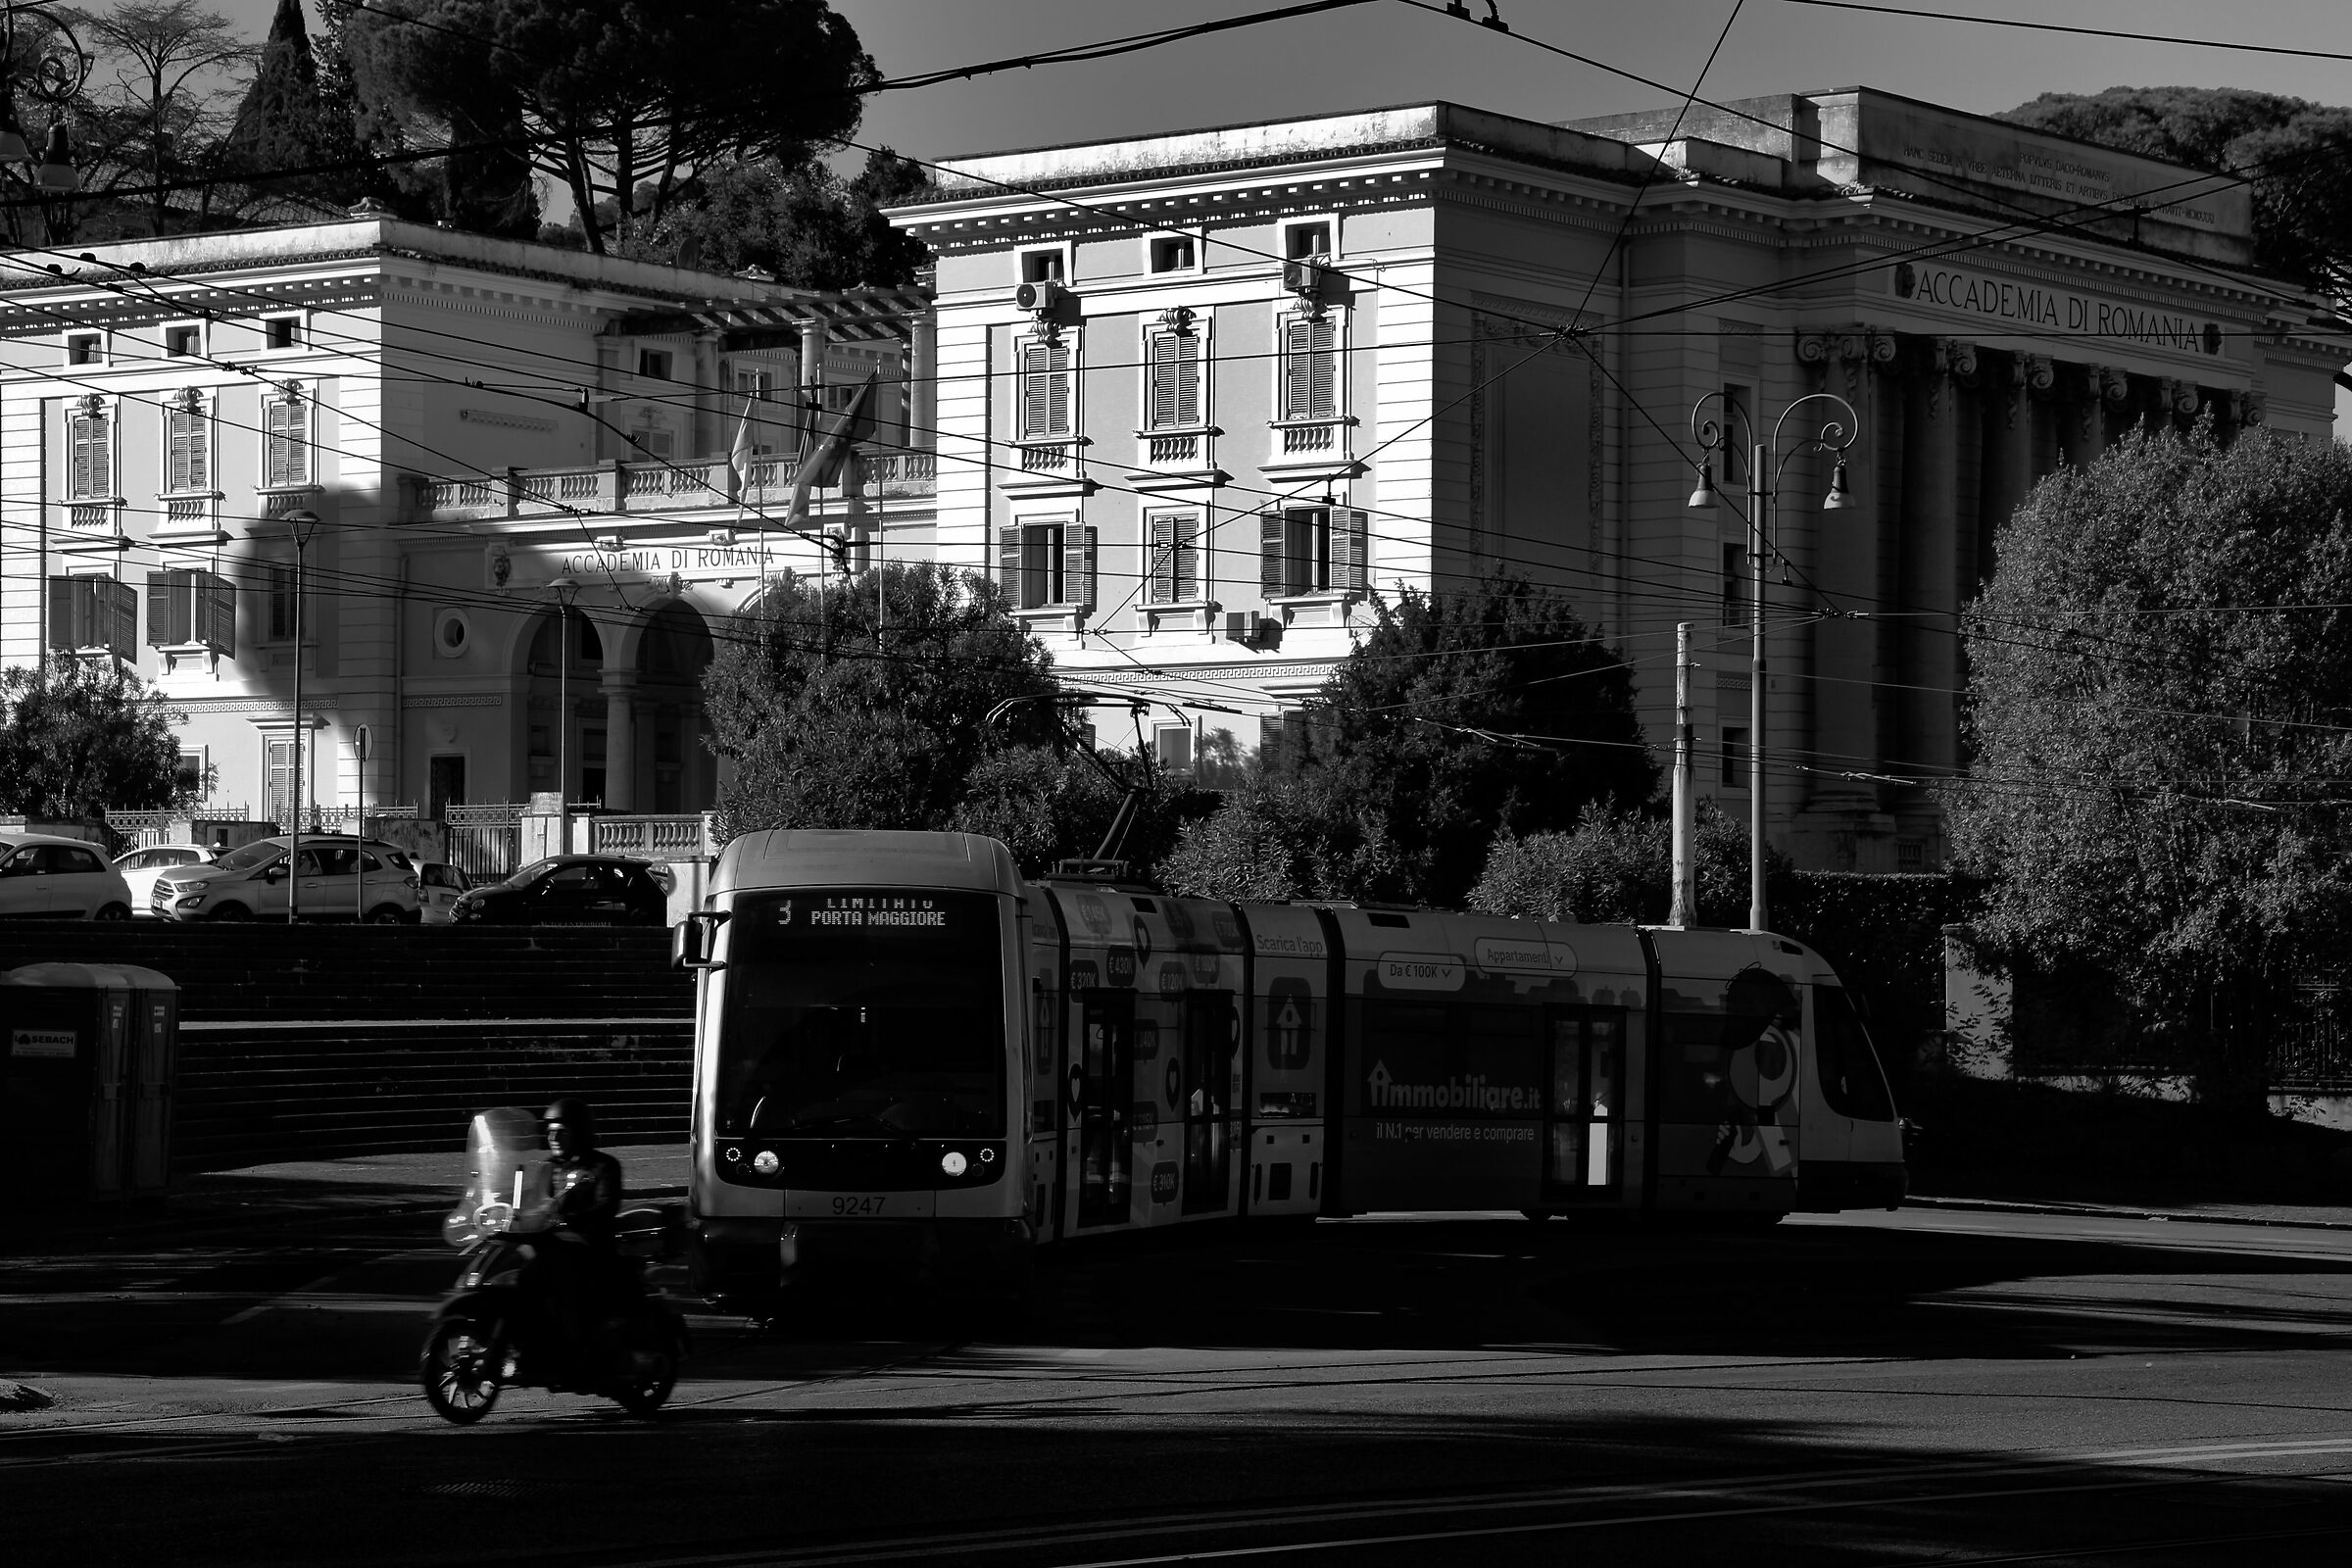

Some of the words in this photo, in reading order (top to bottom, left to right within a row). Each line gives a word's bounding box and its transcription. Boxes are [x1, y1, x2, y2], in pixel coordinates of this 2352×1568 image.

[1916, 270, 2059, 326] ACCADEMIA
[2068, 296, 2088, 332] DI
[2098, 302, 2200, 354] ROMANIA
[562, 552, 662, 574] ACCADEMIA
[671, 549, 688, 569] DI
[698, 546, 774, 568] ROMANA
[777, 899, 792, 925] 3
[810, 910, 862, 925] PORTA
[867, 911, 946, 926] MAGGIORE
[1256, 933, 1297, 952] Scarica
[1296, 934, 1323, 957] l'app
[1487, 948, 1551, 965] Appartamenti
[1390, 963, 1402, 977] Da
[1413, 964, 1439, 979] 100K
[1376, 1122, 1384, 1139] il
[1385, 1122, 1402, 1140] N.1
[1426, 1123, 1472, 1141] vendere
[1473, 1127, 1482, 1141] e
[1483, 1127, 1535, 1145] comprare
[833, 1197, 886, 1215] 9247
